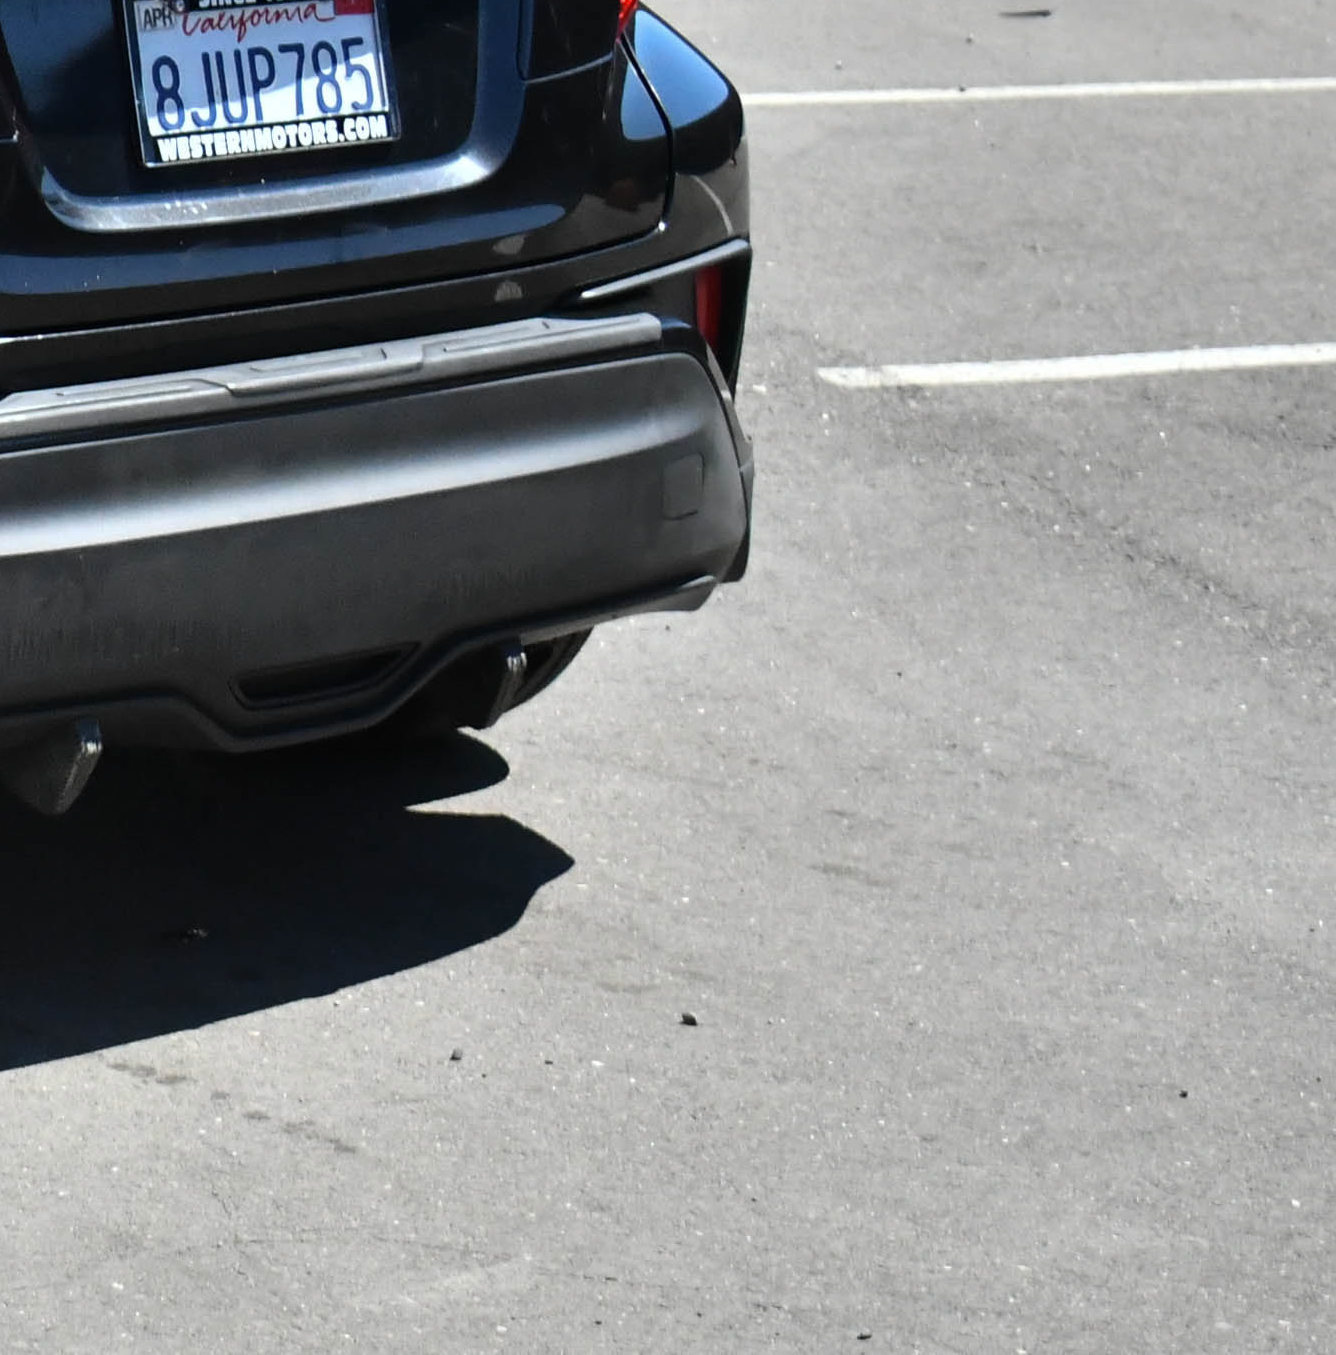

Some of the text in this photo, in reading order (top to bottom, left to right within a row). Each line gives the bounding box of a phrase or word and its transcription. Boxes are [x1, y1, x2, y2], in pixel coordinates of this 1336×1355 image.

[143, 6, 174, 30] APR
[182, 2, 336, 44] California
[152, 36, 375, 132] 8JUP785
[157, 114, 389, 163] WESTERNMOTORS.COM
